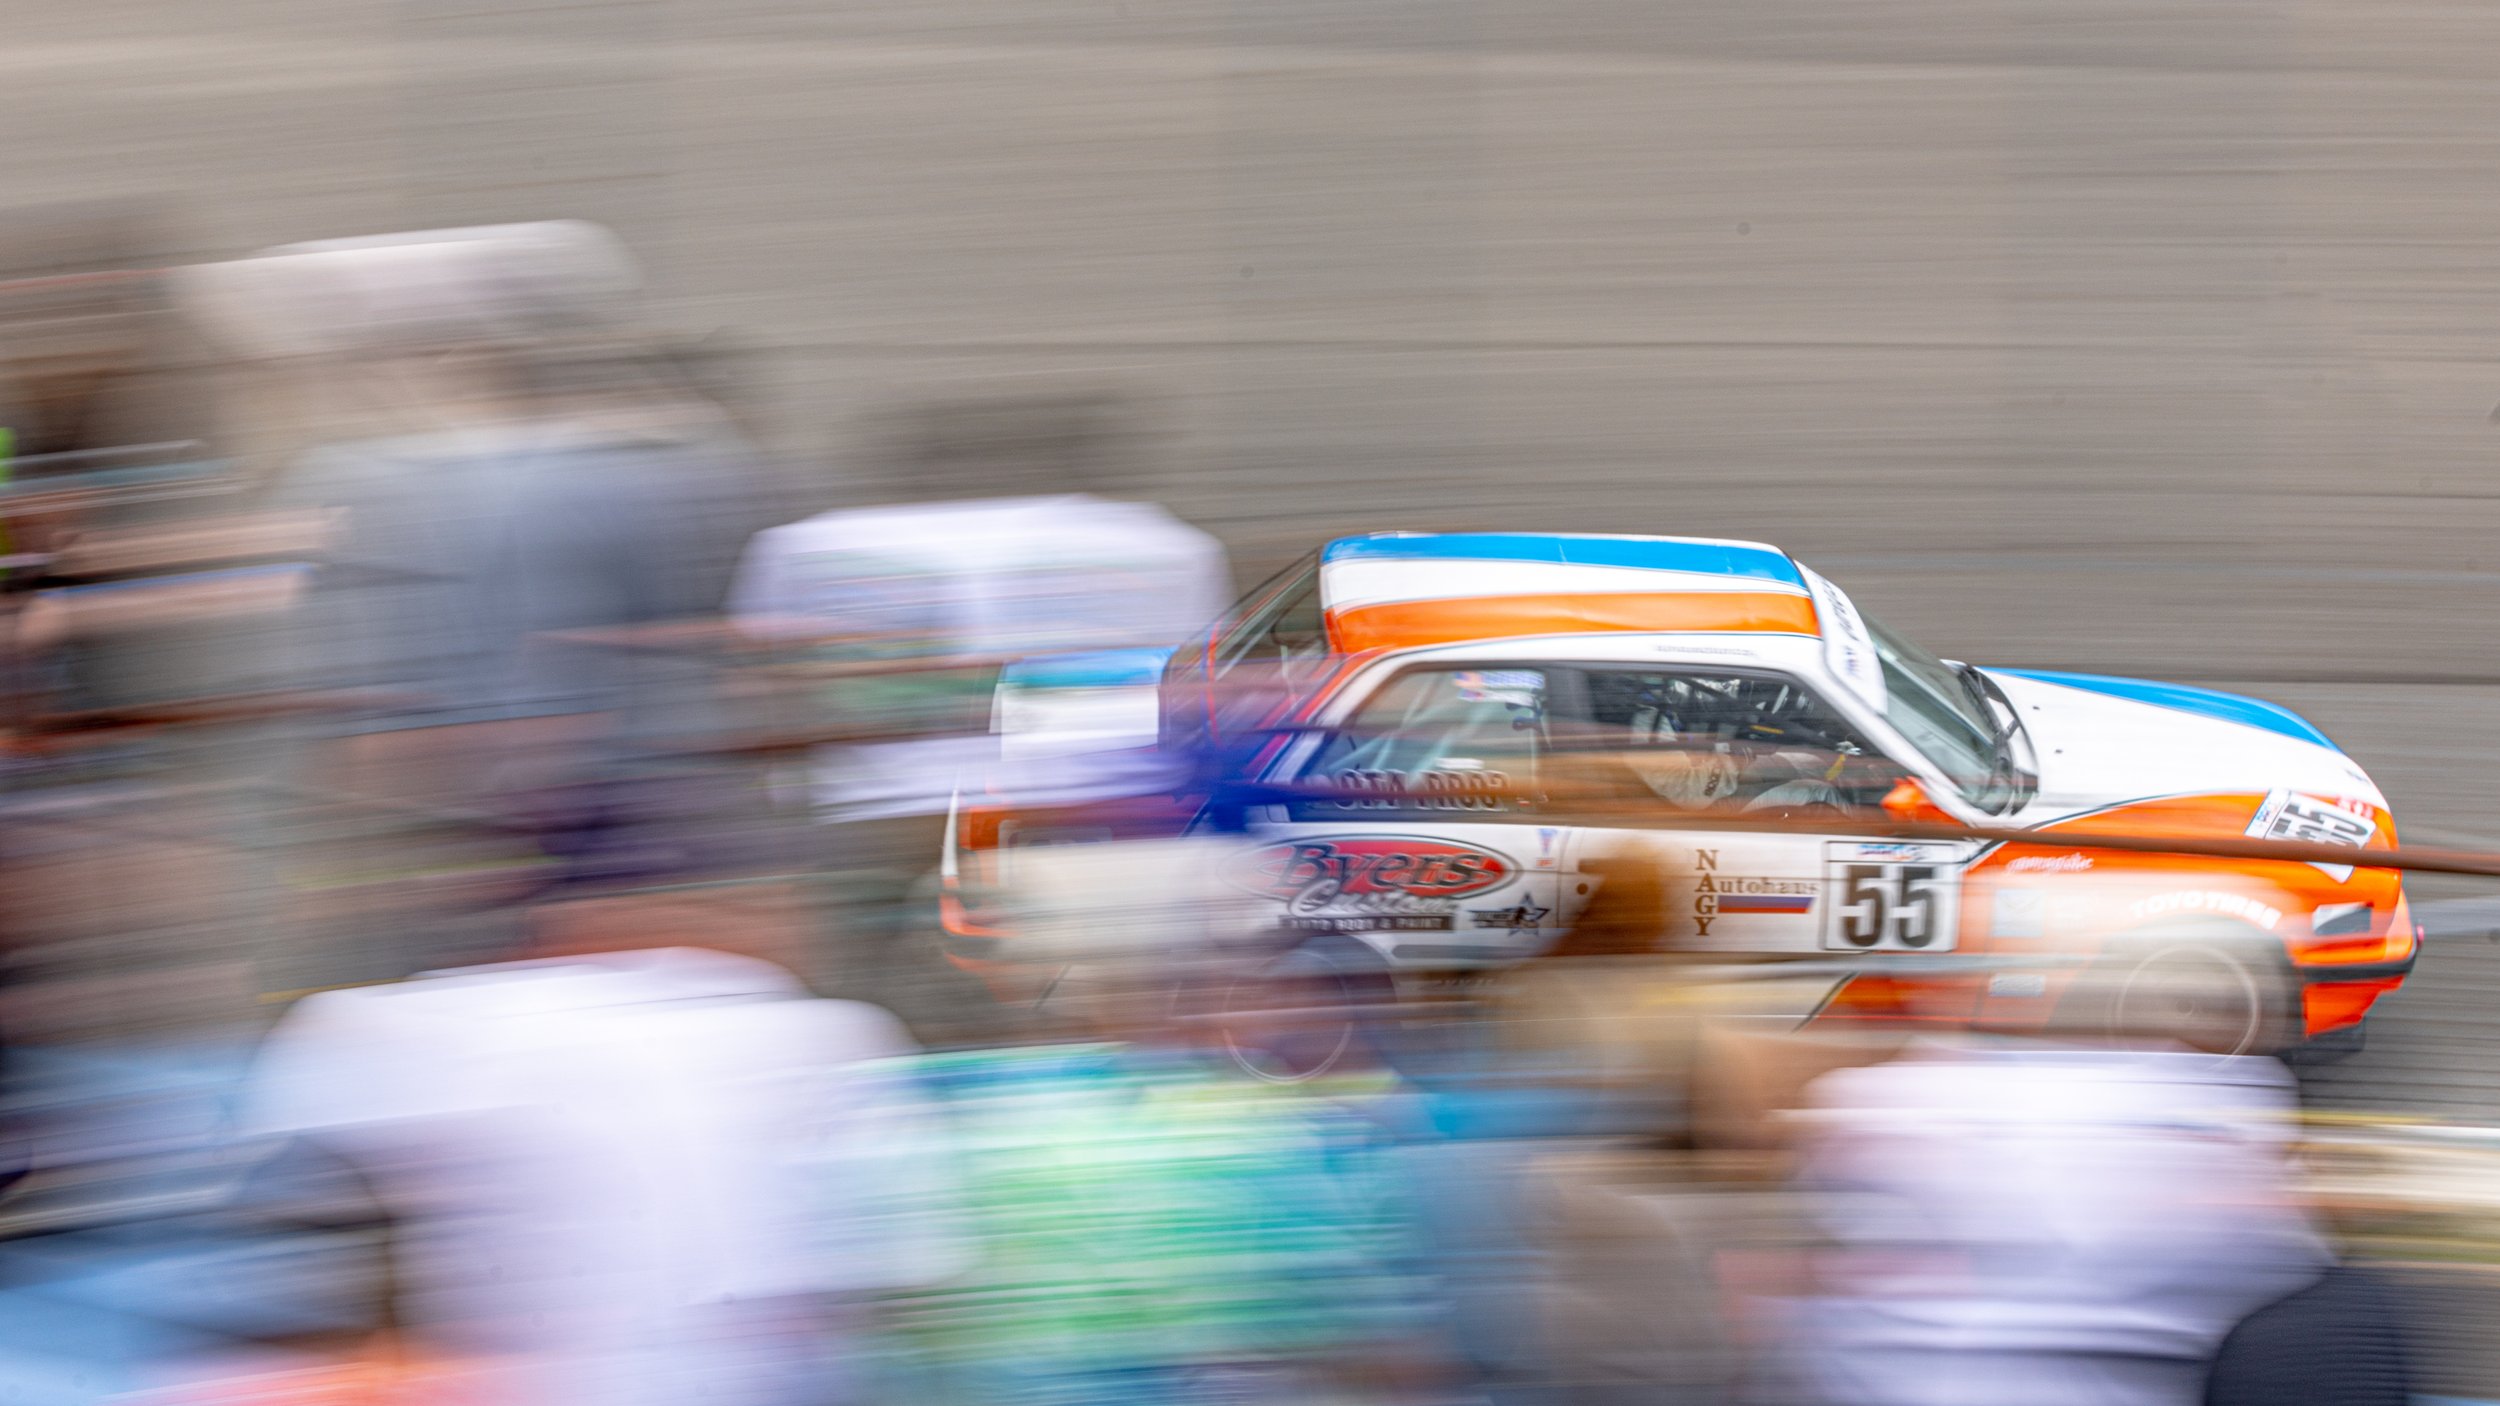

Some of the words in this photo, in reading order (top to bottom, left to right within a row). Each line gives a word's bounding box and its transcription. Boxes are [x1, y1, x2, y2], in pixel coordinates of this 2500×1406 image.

[1272, 843, 1496, 888] Byers
[1693, 848, 1720, 936] NAGY
[1843, 864, 1935, 947] 55
